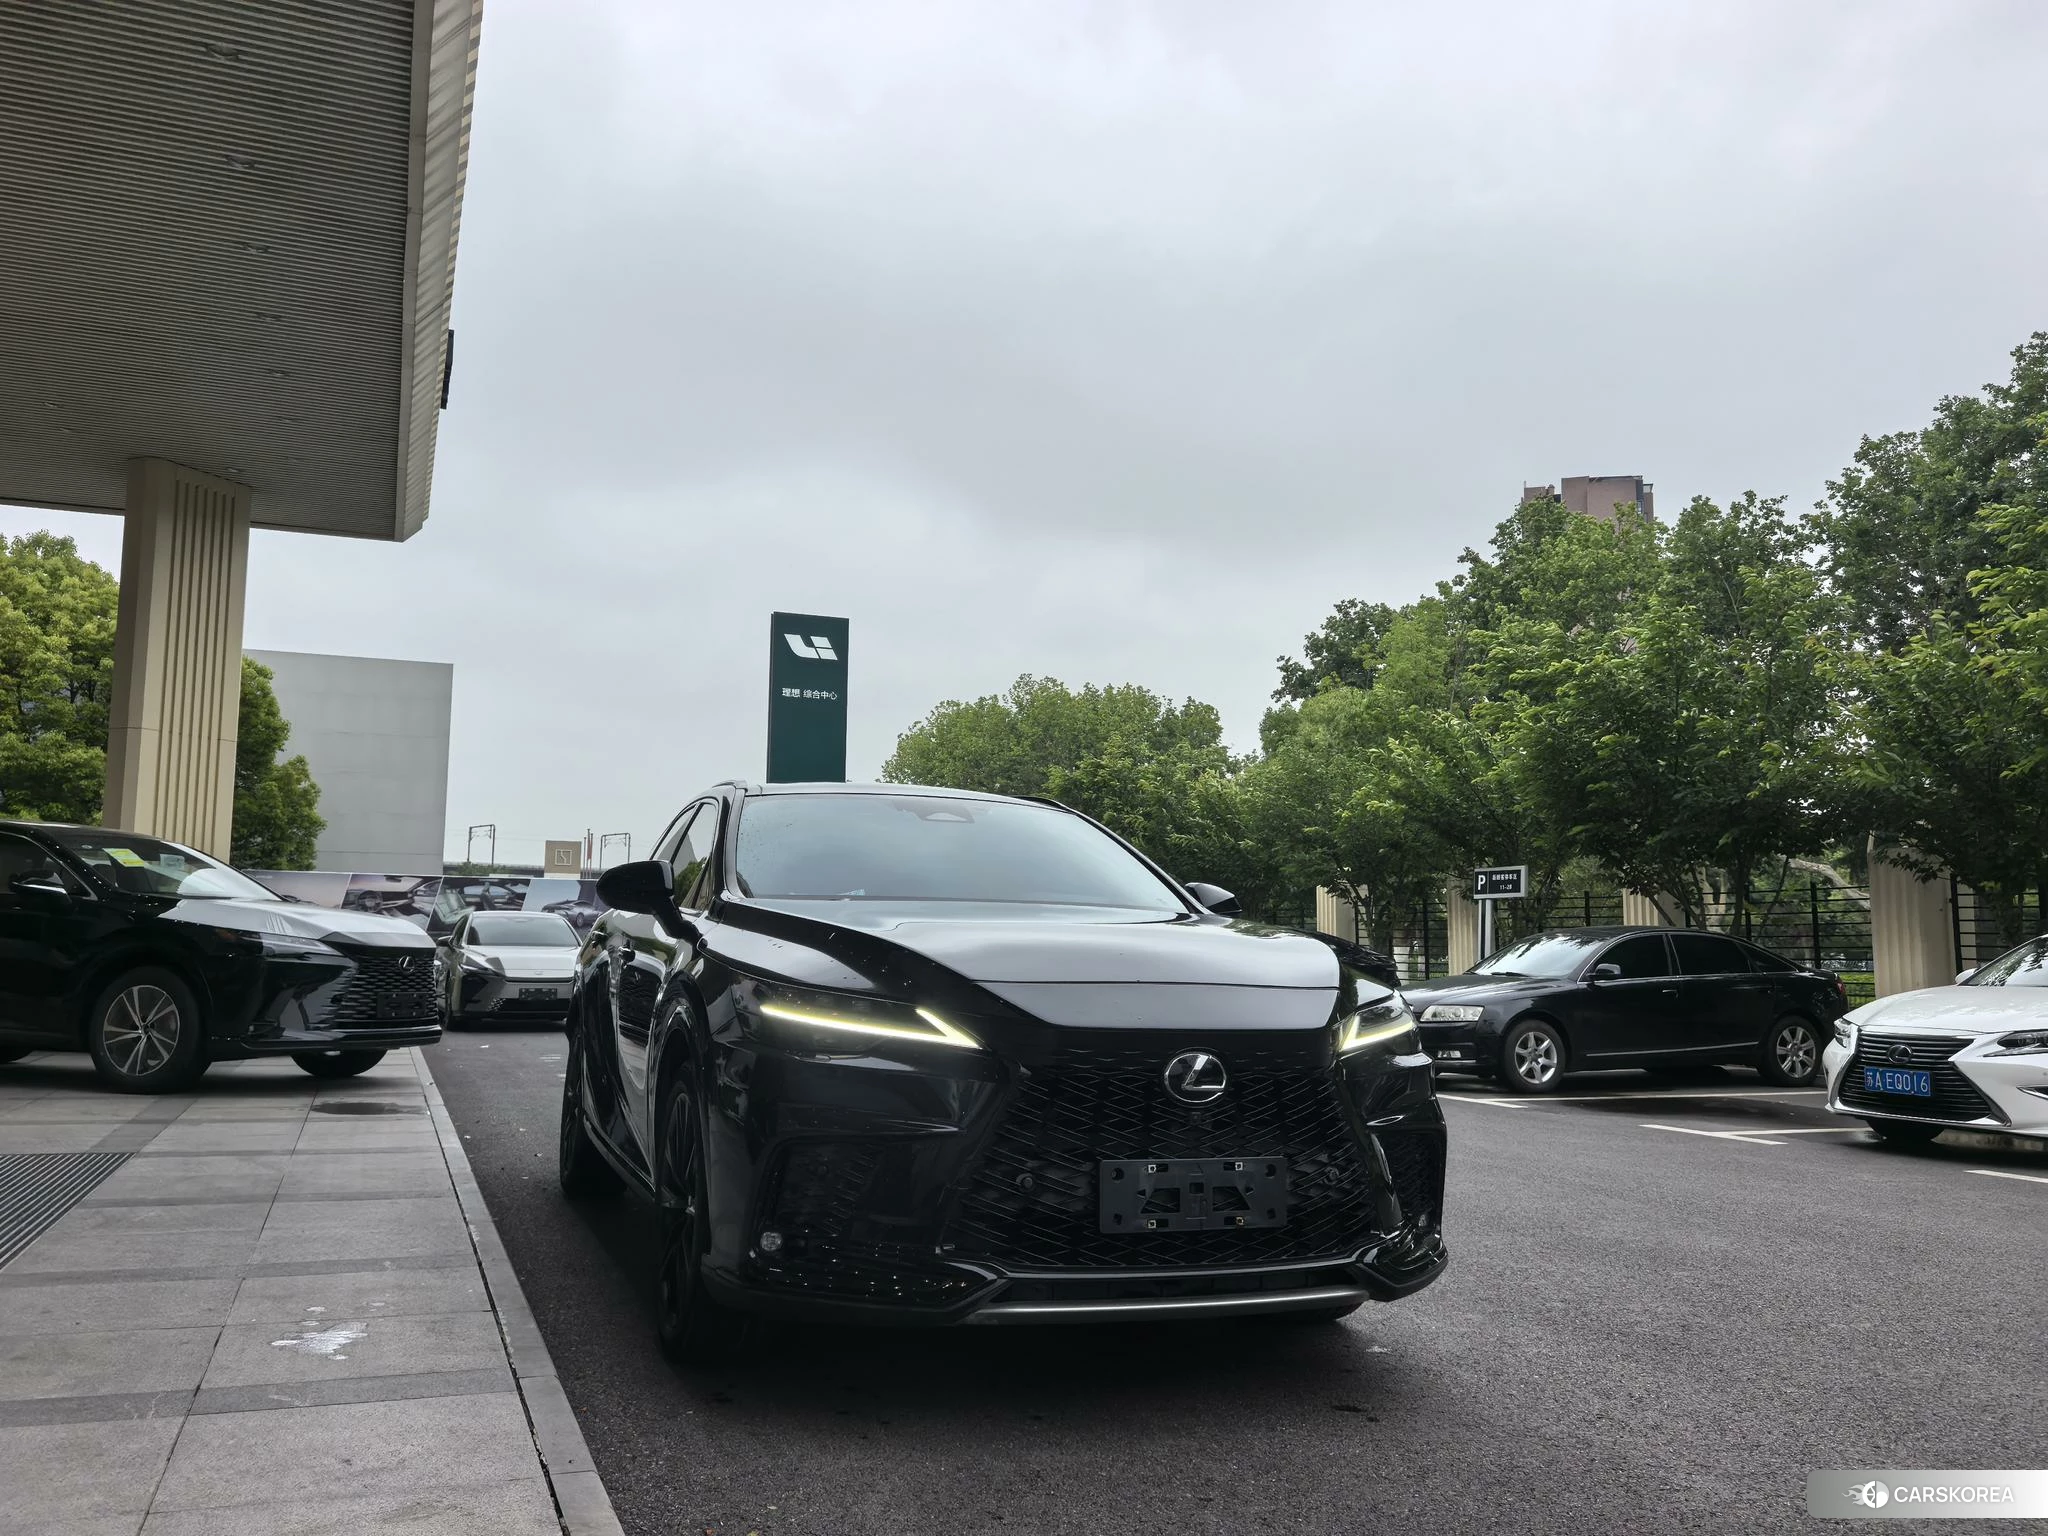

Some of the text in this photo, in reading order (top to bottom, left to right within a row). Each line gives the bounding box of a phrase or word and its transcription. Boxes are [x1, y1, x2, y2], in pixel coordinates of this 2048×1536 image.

[803, 689, 837, 700] 综合中心
[1477, 874, 1486, 891] P
